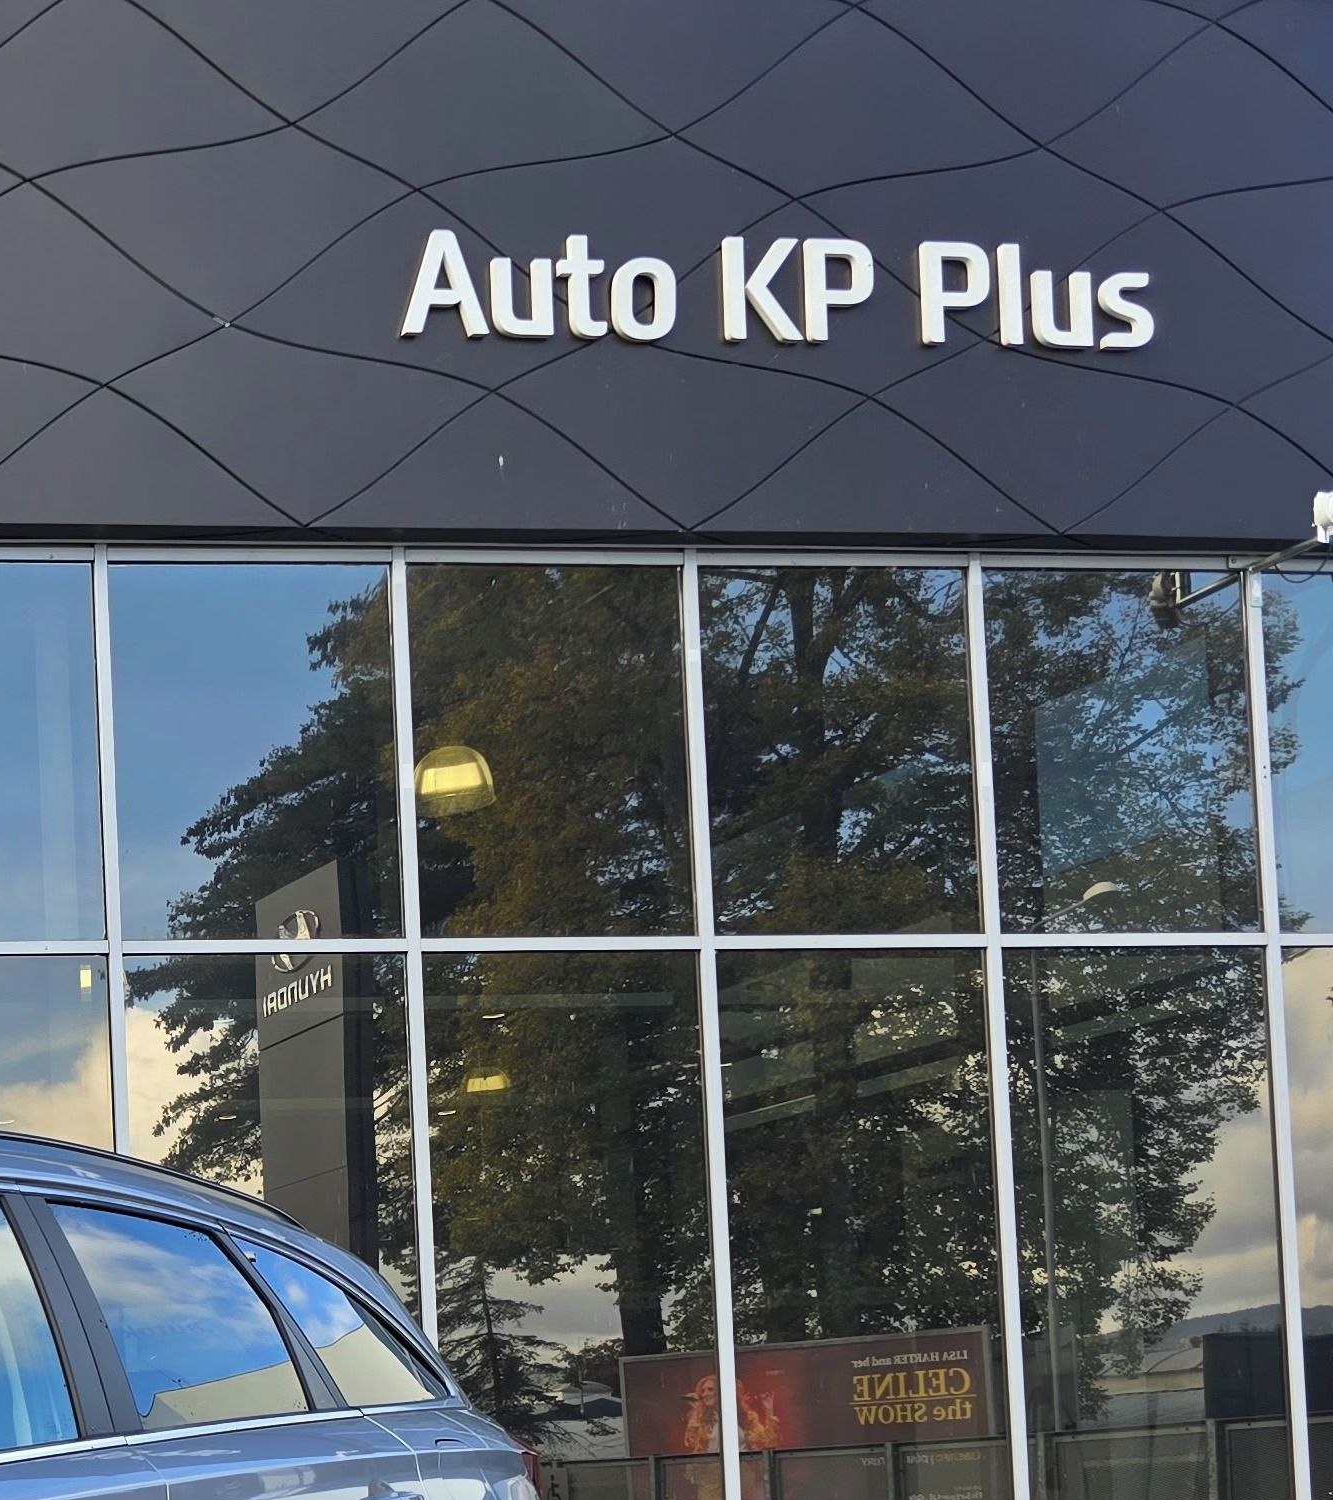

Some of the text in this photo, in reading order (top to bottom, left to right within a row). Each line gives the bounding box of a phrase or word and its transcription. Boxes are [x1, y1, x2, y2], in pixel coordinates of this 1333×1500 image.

[399, 228, 1156, 350] Auto KP Plus
